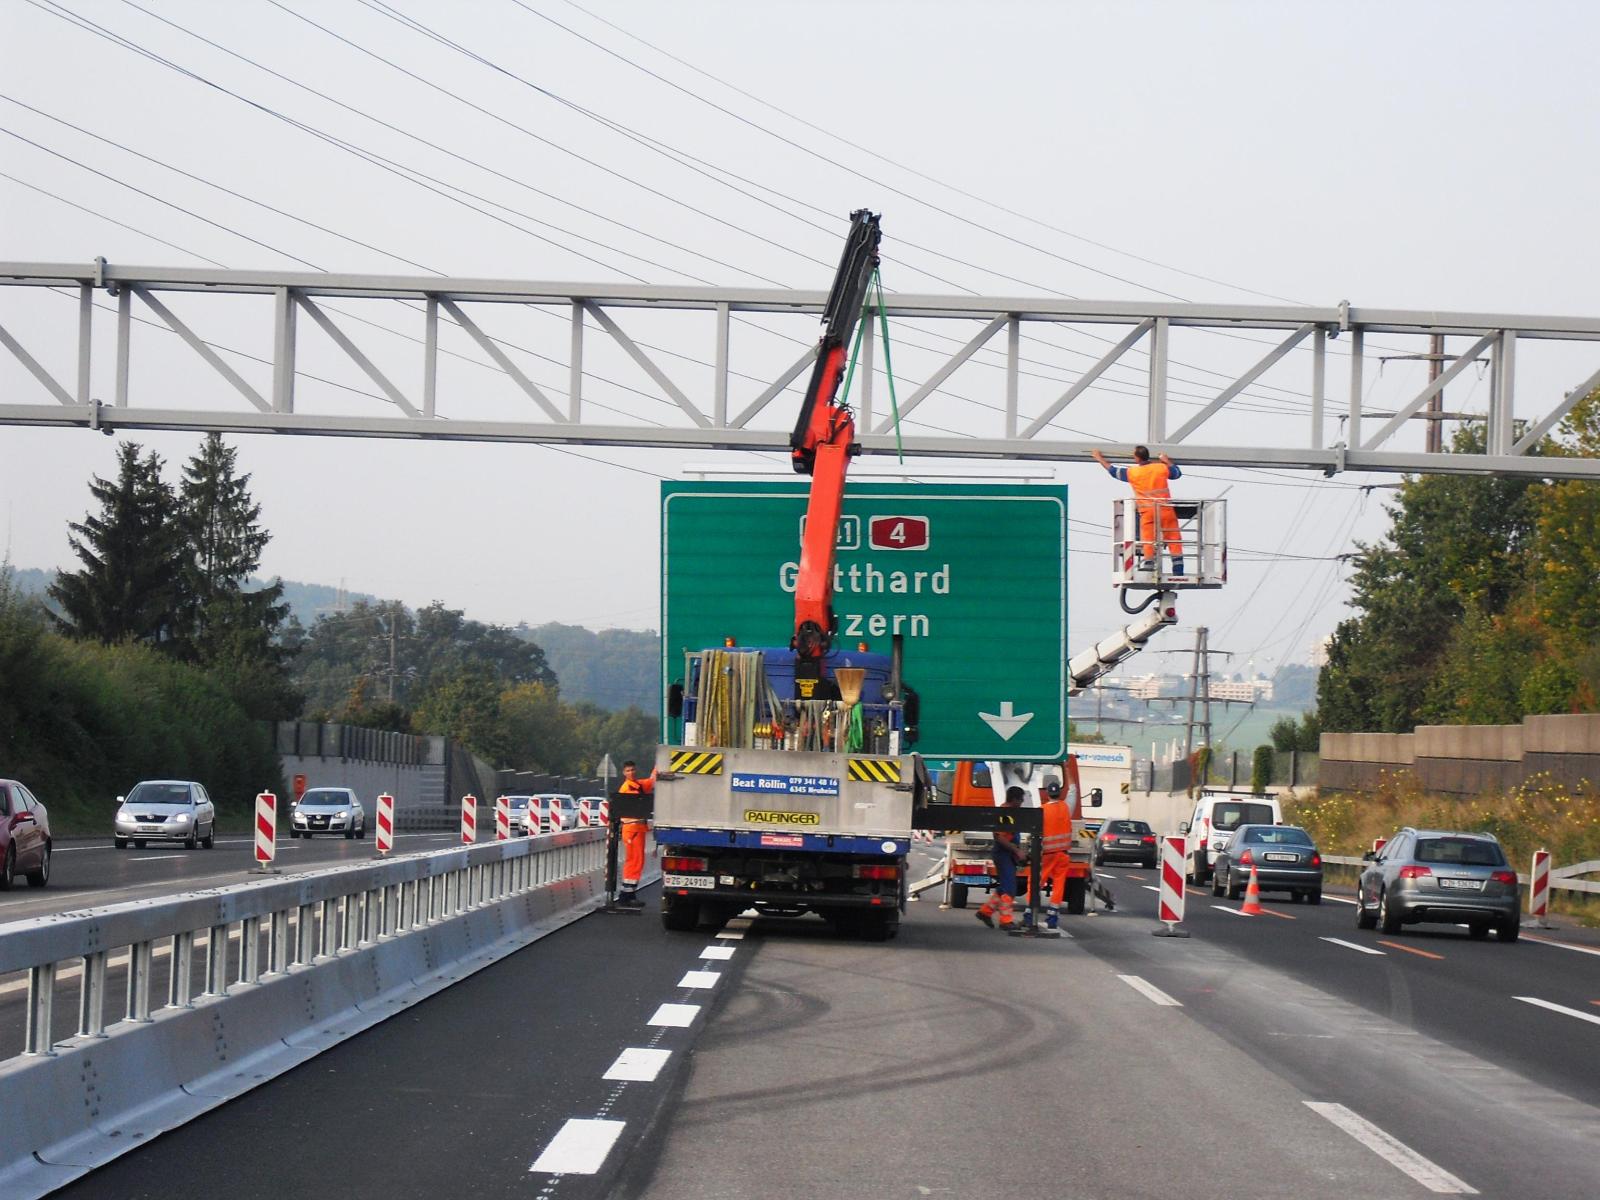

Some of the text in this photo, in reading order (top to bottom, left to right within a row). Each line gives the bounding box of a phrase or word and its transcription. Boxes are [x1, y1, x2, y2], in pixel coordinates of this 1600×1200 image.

[889, 522, 906, 544] 4
[779, 561, 950, 594] Gtthard
[828, 613, 930, 637] zern
[732, 777, 787, 789] Beat Röllin
[788, 777, 803, 785] 079
[748, 811, 816, 824] PALFINGER
